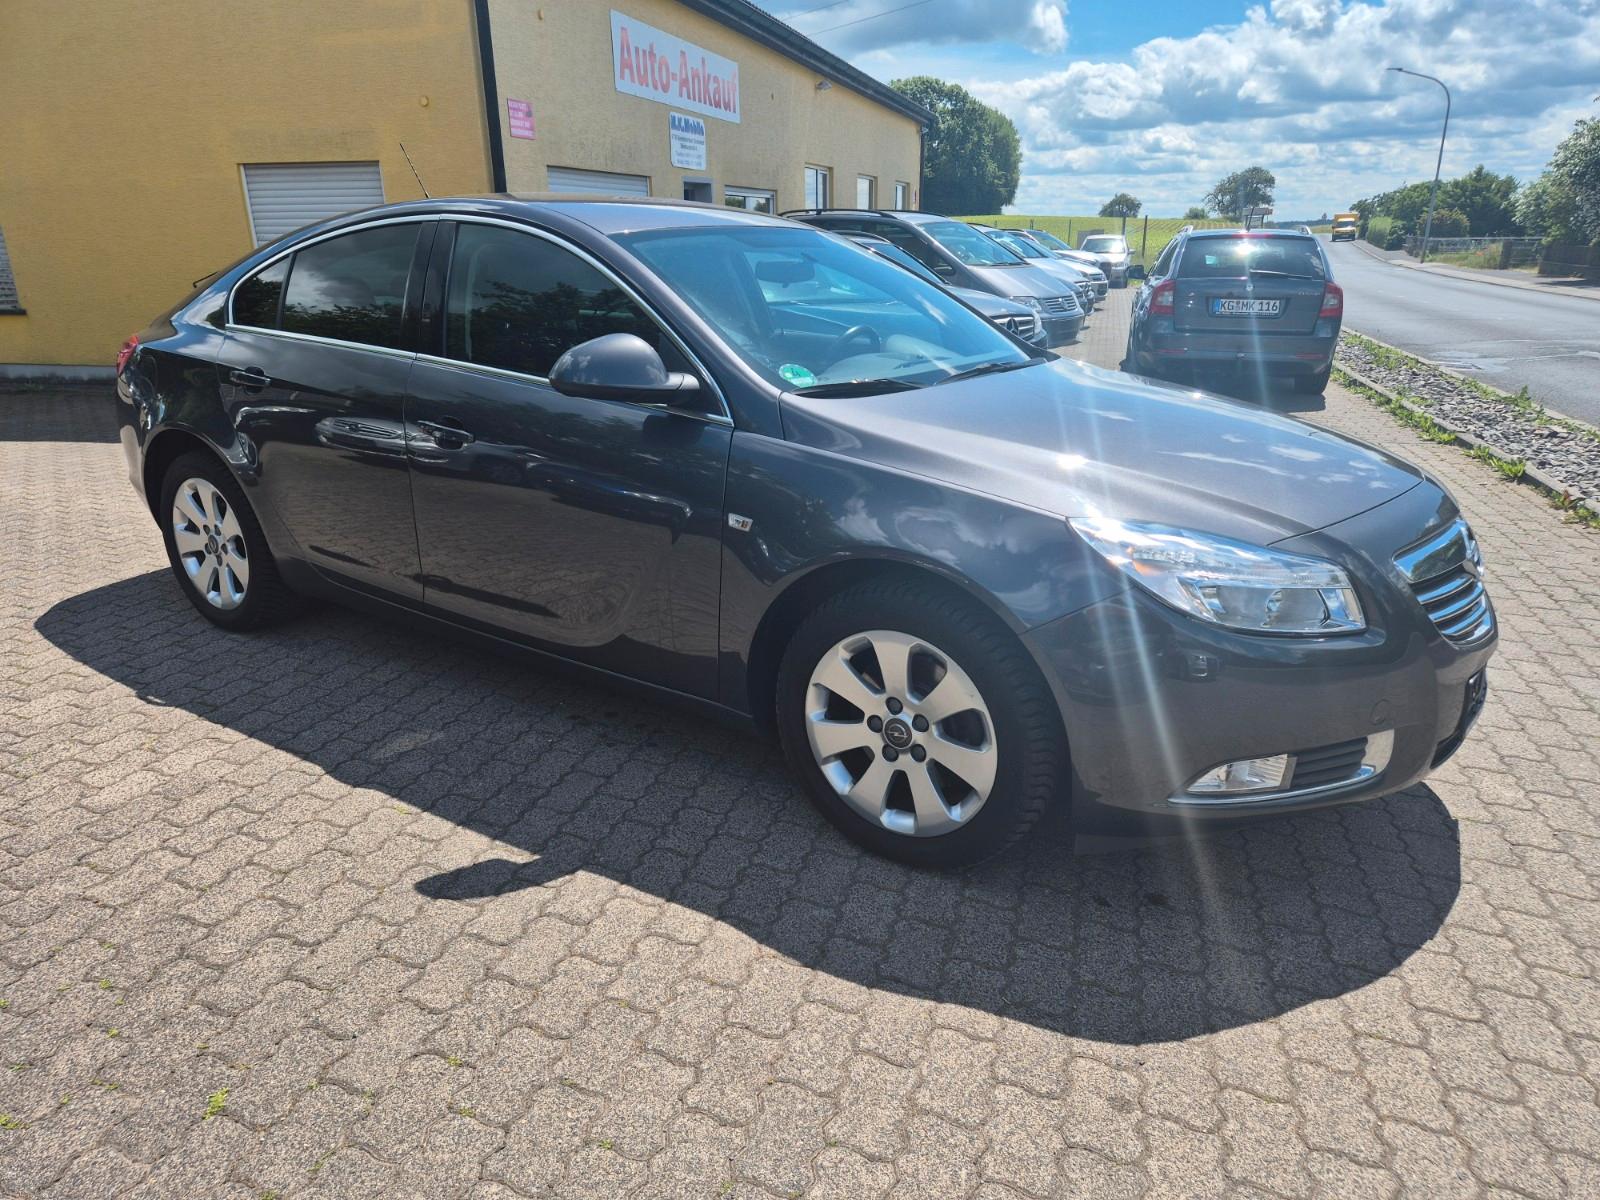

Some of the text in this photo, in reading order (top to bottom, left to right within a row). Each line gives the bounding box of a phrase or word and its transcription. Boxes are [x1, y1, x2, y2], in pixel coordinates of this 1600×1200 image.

[620, 26, 737, 114] Auto-Ankauf
[1220, 300, 1278, 312] KG MK 116
